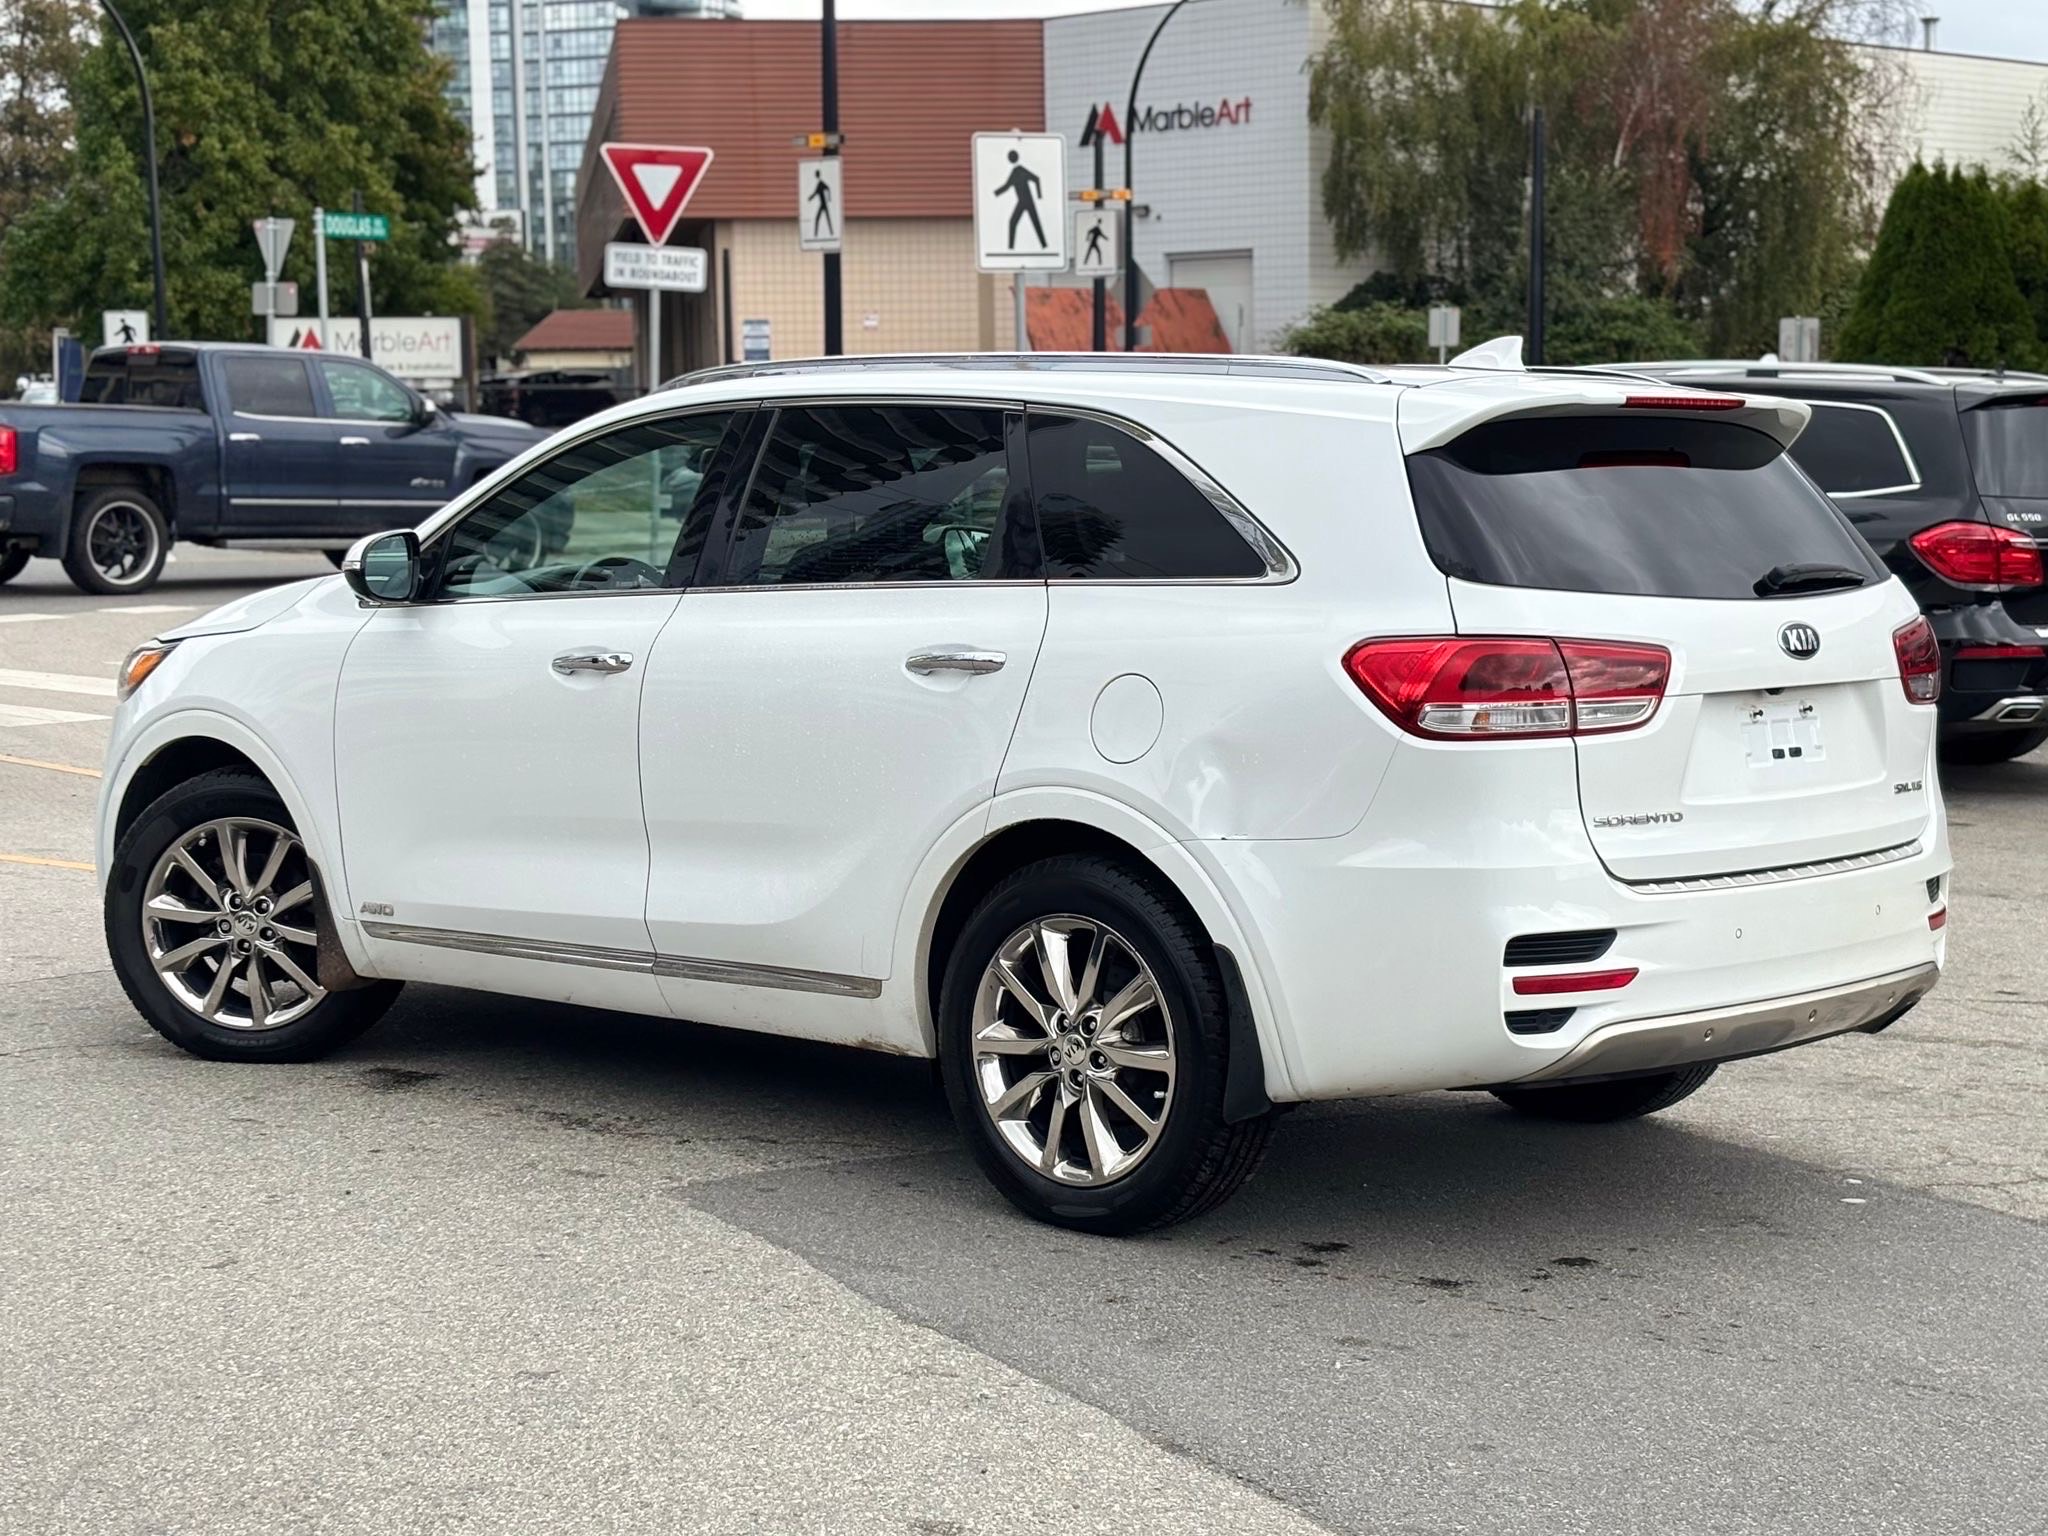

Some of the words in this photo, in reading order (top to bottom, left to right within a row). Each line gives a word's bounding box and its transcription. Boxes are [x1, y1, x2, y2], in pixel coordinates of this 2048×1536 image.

[1130, 97, 1252, 132] MarbleArt
[326, 215, 371, 236] DOUGLAS
[614, 251, 641, 264] YIELD
[646, 253, 657, 265] TO
[661, 254, 699, 268] TRAFFIC
[613, 268, 624, 278] IN
[630, 269, 698, 283] ROUNDABOUT
[335, 332, 452, 352] MrbleArt
[2006, 513, 2021, 521] GL
[2021, 513, 2042, 521] 550
[1784, 628, 1818, 651] KIA
[1593, 812, 1684, 828] SORENTO
[360, 901, 394, 916] AWD
